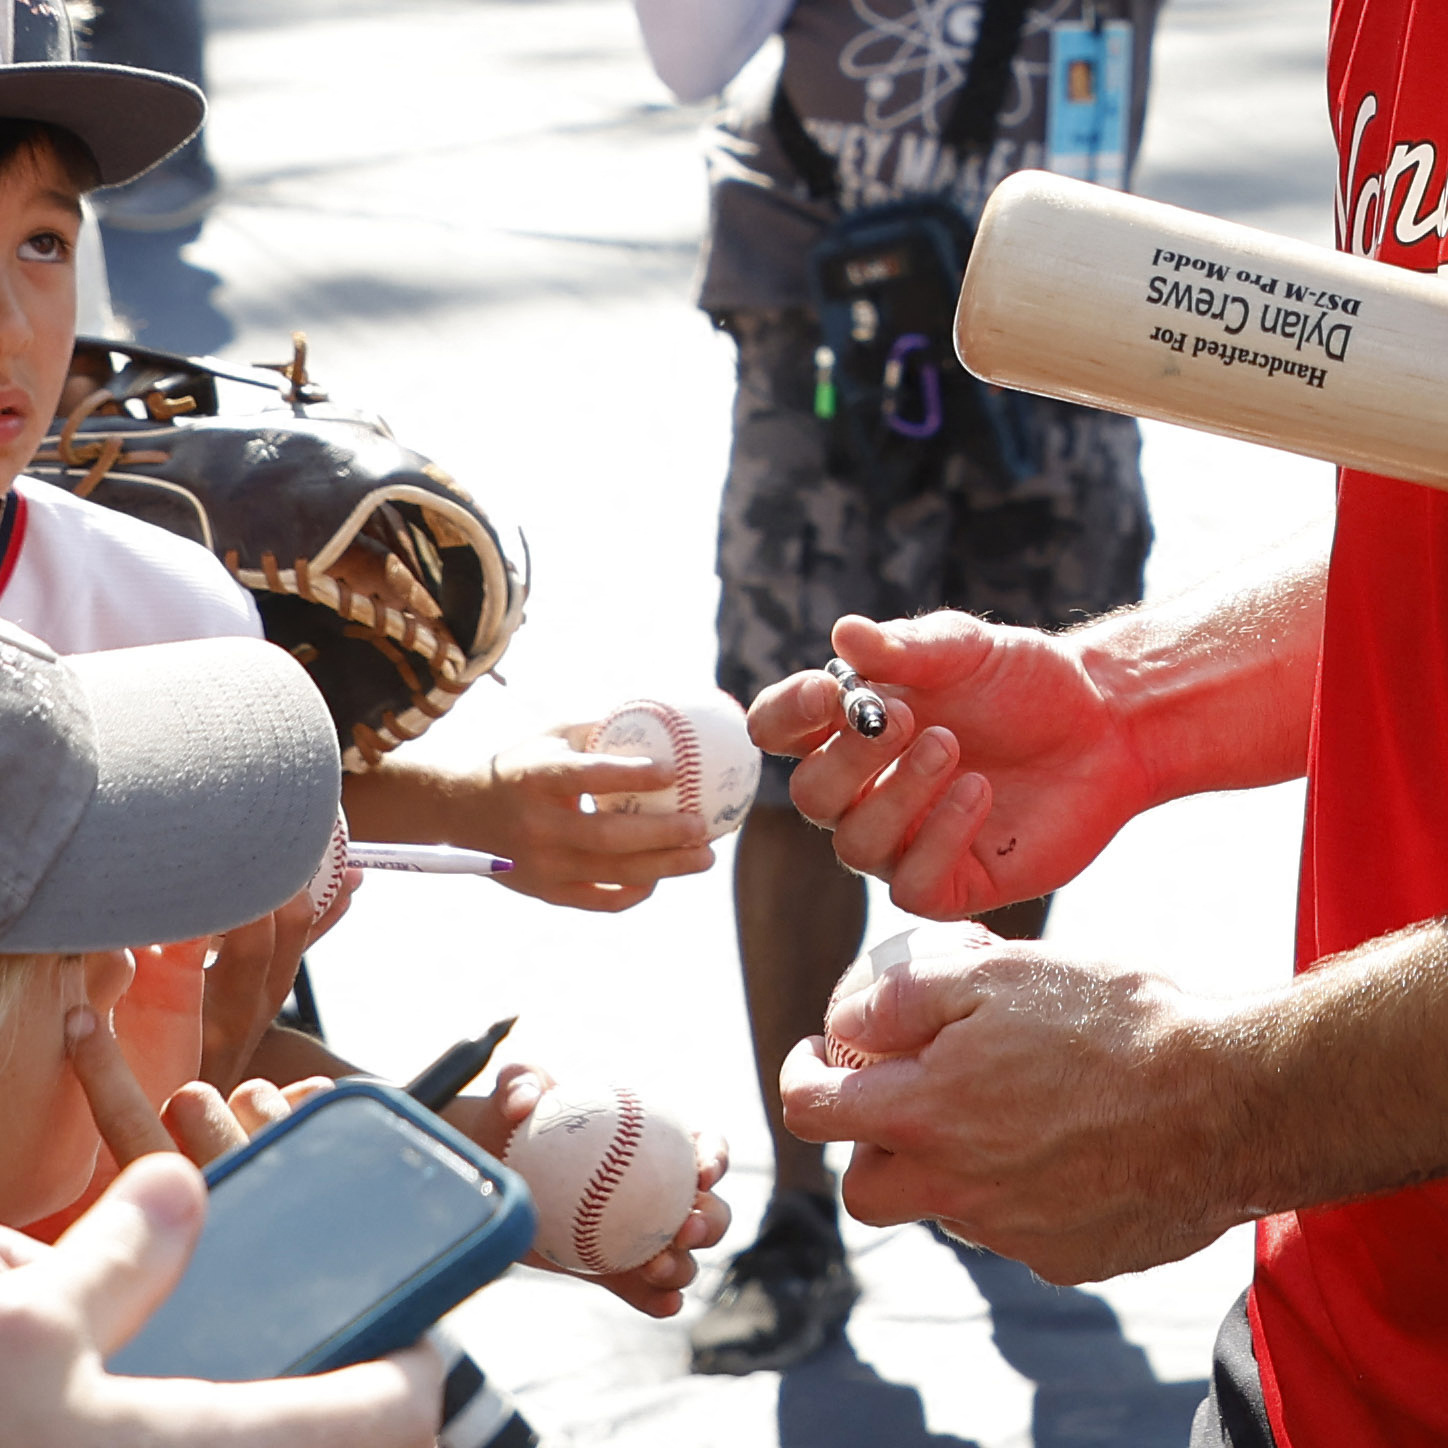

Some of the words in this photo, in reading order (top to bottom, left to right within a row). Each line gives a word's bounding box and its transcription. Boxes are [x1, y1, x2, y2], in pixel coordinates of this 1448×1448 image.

[1152, 248, 1230, 281] Model
[1236, 269, 1280, 292] Pro
[1145, 275, 1250, 335] Crews
[1284, 282, 1363, 316] DS7-M
[1149, 325, 1186, 353] For
[1260, 304, 1353, 362] Dylan
[1192, 336, 1328, 389] Handcrafted
